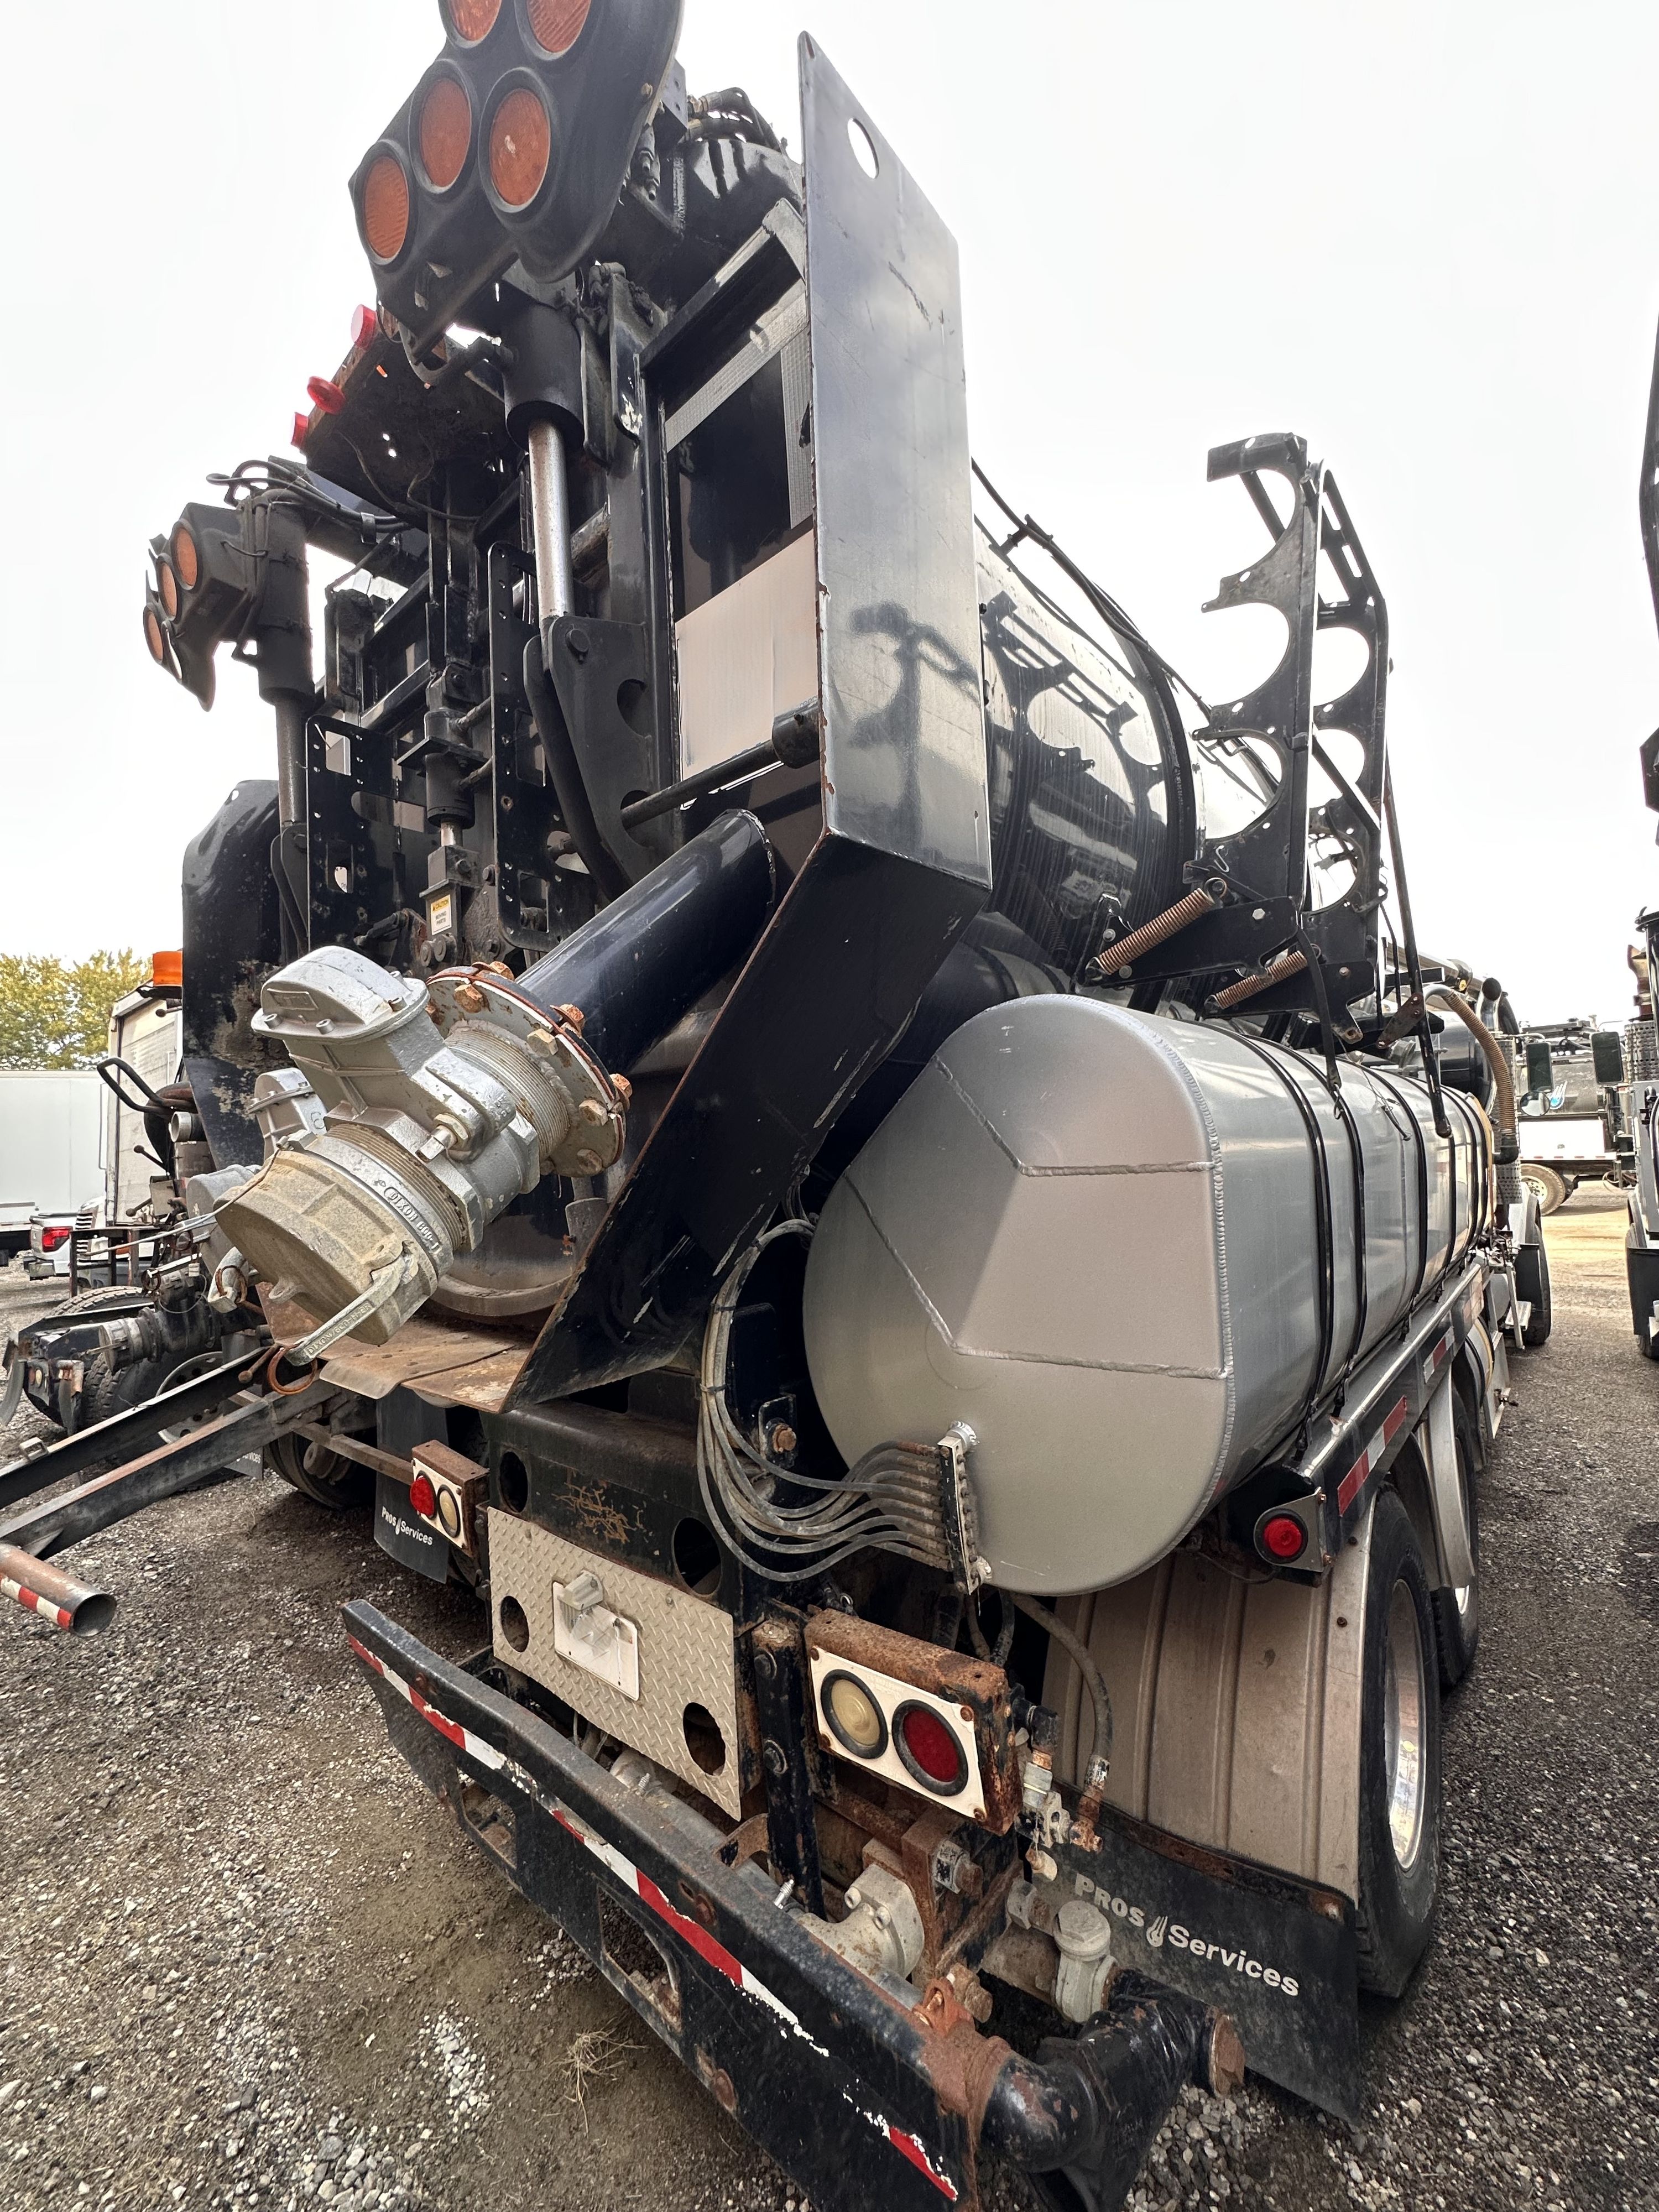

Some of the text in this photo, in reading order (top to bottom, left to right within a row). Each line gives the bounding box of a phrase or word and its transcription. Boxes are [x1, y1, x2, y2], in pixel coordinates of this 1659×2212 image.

[388, 1193, 419, 1222] DIXON
[400, 1520, 433, 1546] Services
[1168, 1924, 1300, 1996] Services
